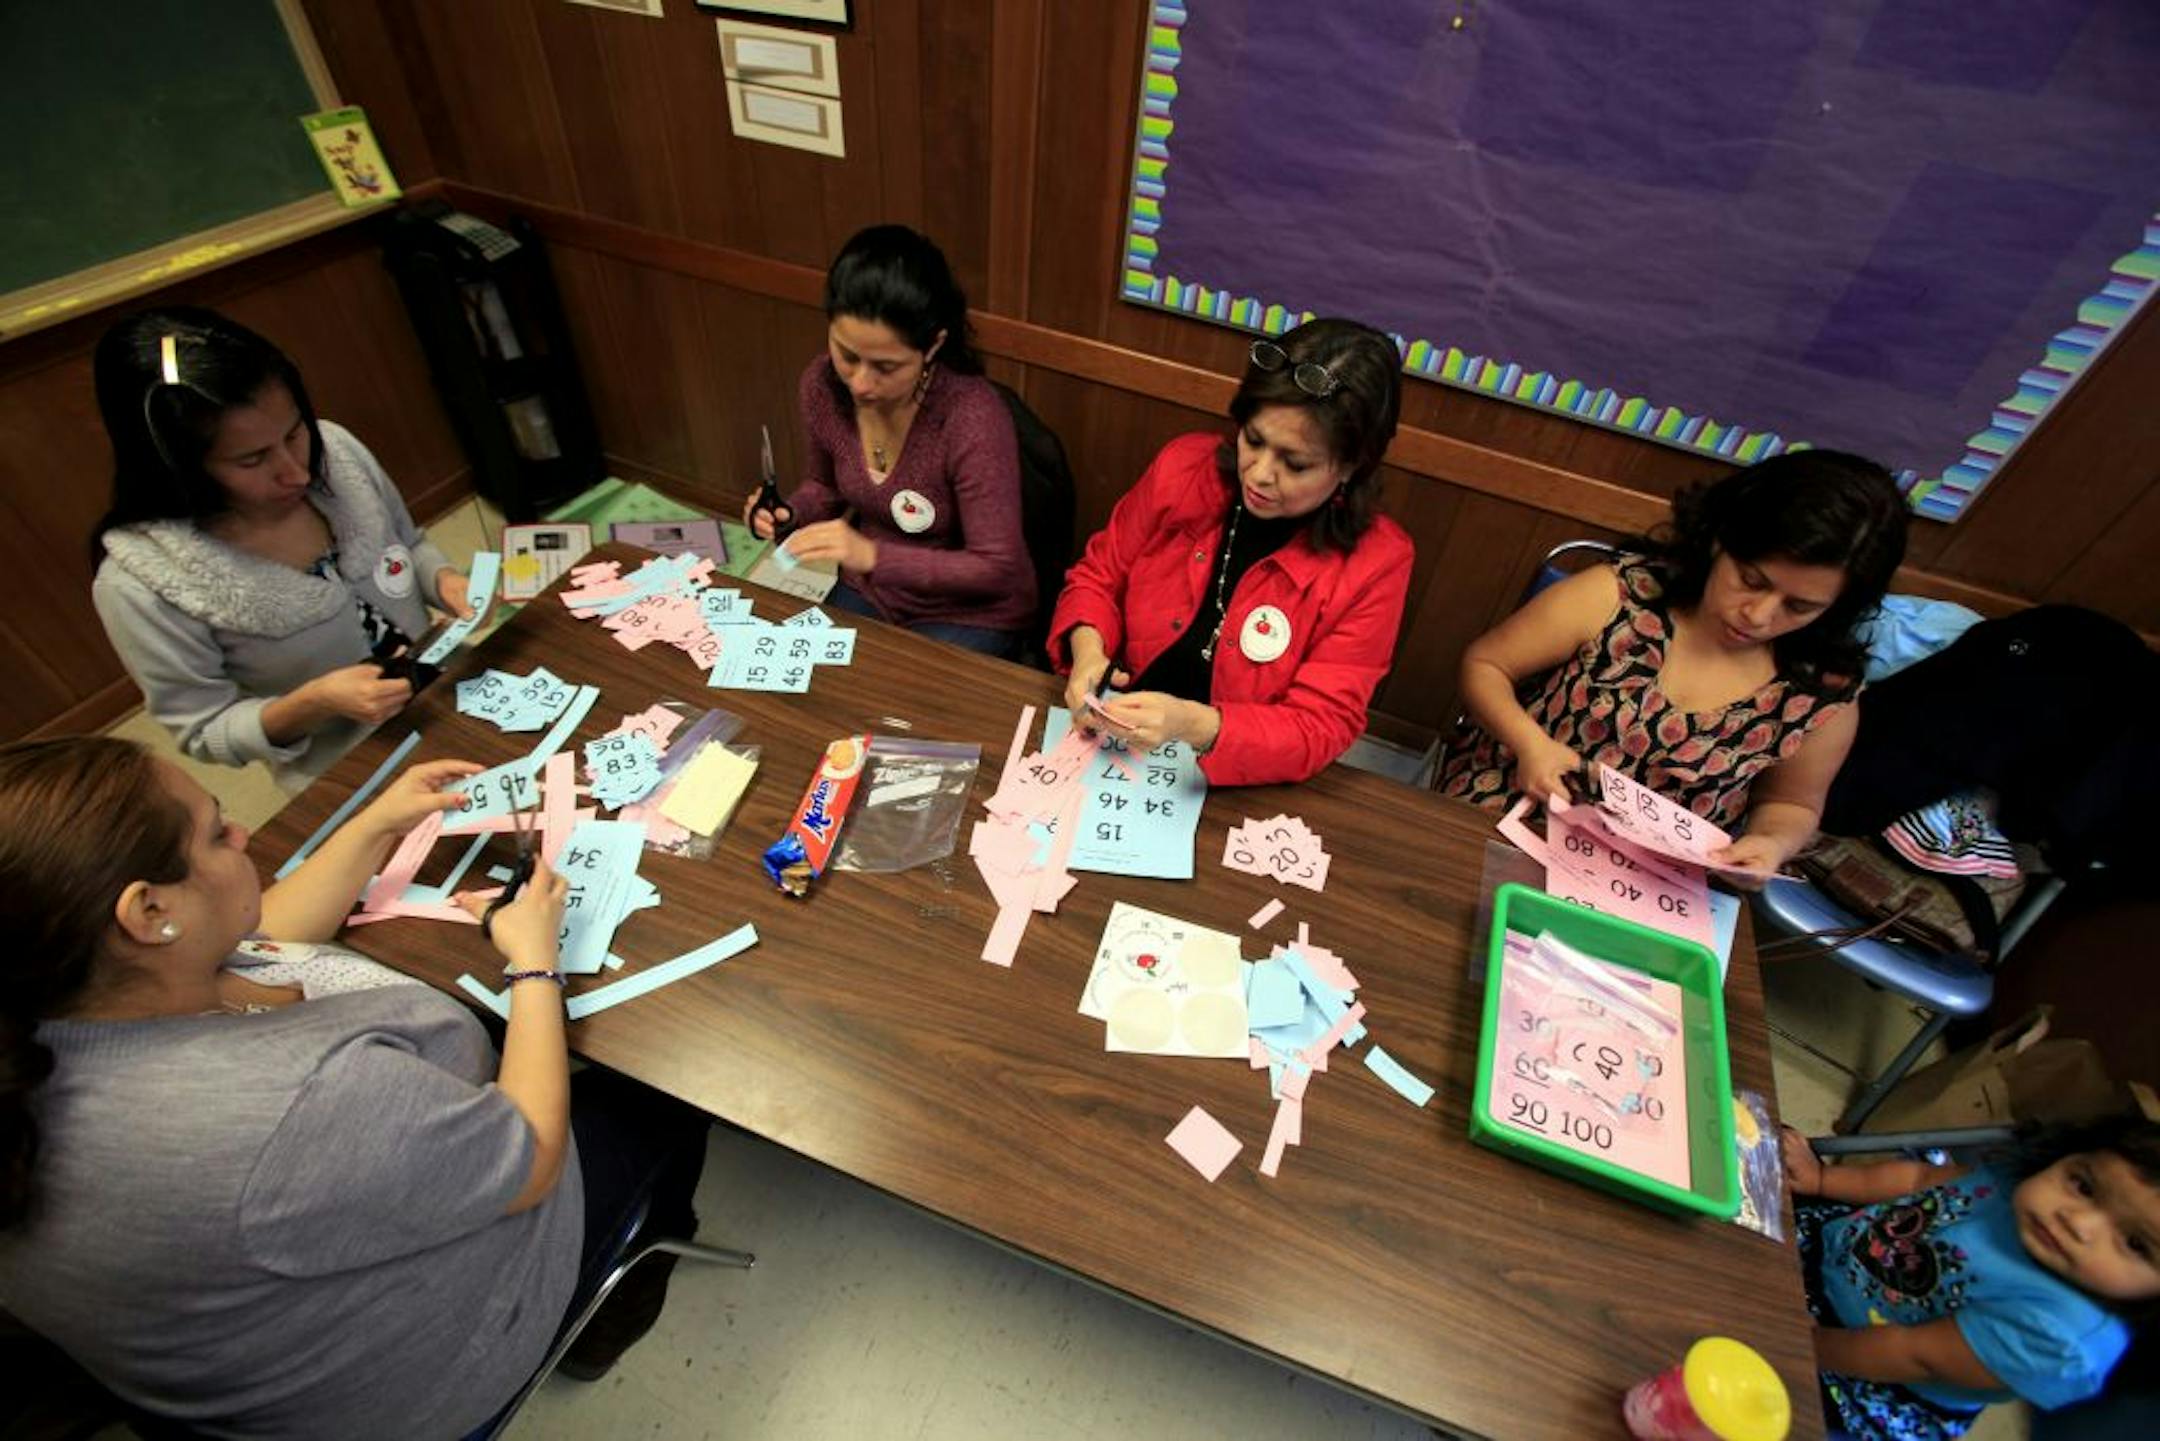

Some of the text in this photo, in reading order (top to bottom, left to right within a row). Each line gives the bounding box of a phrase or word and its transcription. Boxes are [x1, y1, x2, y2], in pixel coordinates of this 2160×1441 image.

[747, 636, 777, 684] 15 29
[782, 638, 811, 687] 46 59
[825, 640, 847, 659] 83
[606, 753, 637, 775] 83
[1028, 762, 1059, 786] 40
[499, 771, 527, 796] 46
[1146, 768, 1177, 788] 62
[1098, 791, 1175, 817] 34 46
[1640, 793, 1660, 822] 60
[1096, 822, 1123, 841] 15
[1674, 811, 1693, 841] 30
[567, 846, 602, 870] 34
[1565, 835, 1594, 858] 80
[1269, 847, 1299, 873] 20
[1610, 878, 1689, 918] 30 40
[1514, 1050, 1551, 1082] 60
[1594, 1045, 1624, 1081] 40
[1510, 1092, 1614, 1150] 90 100
